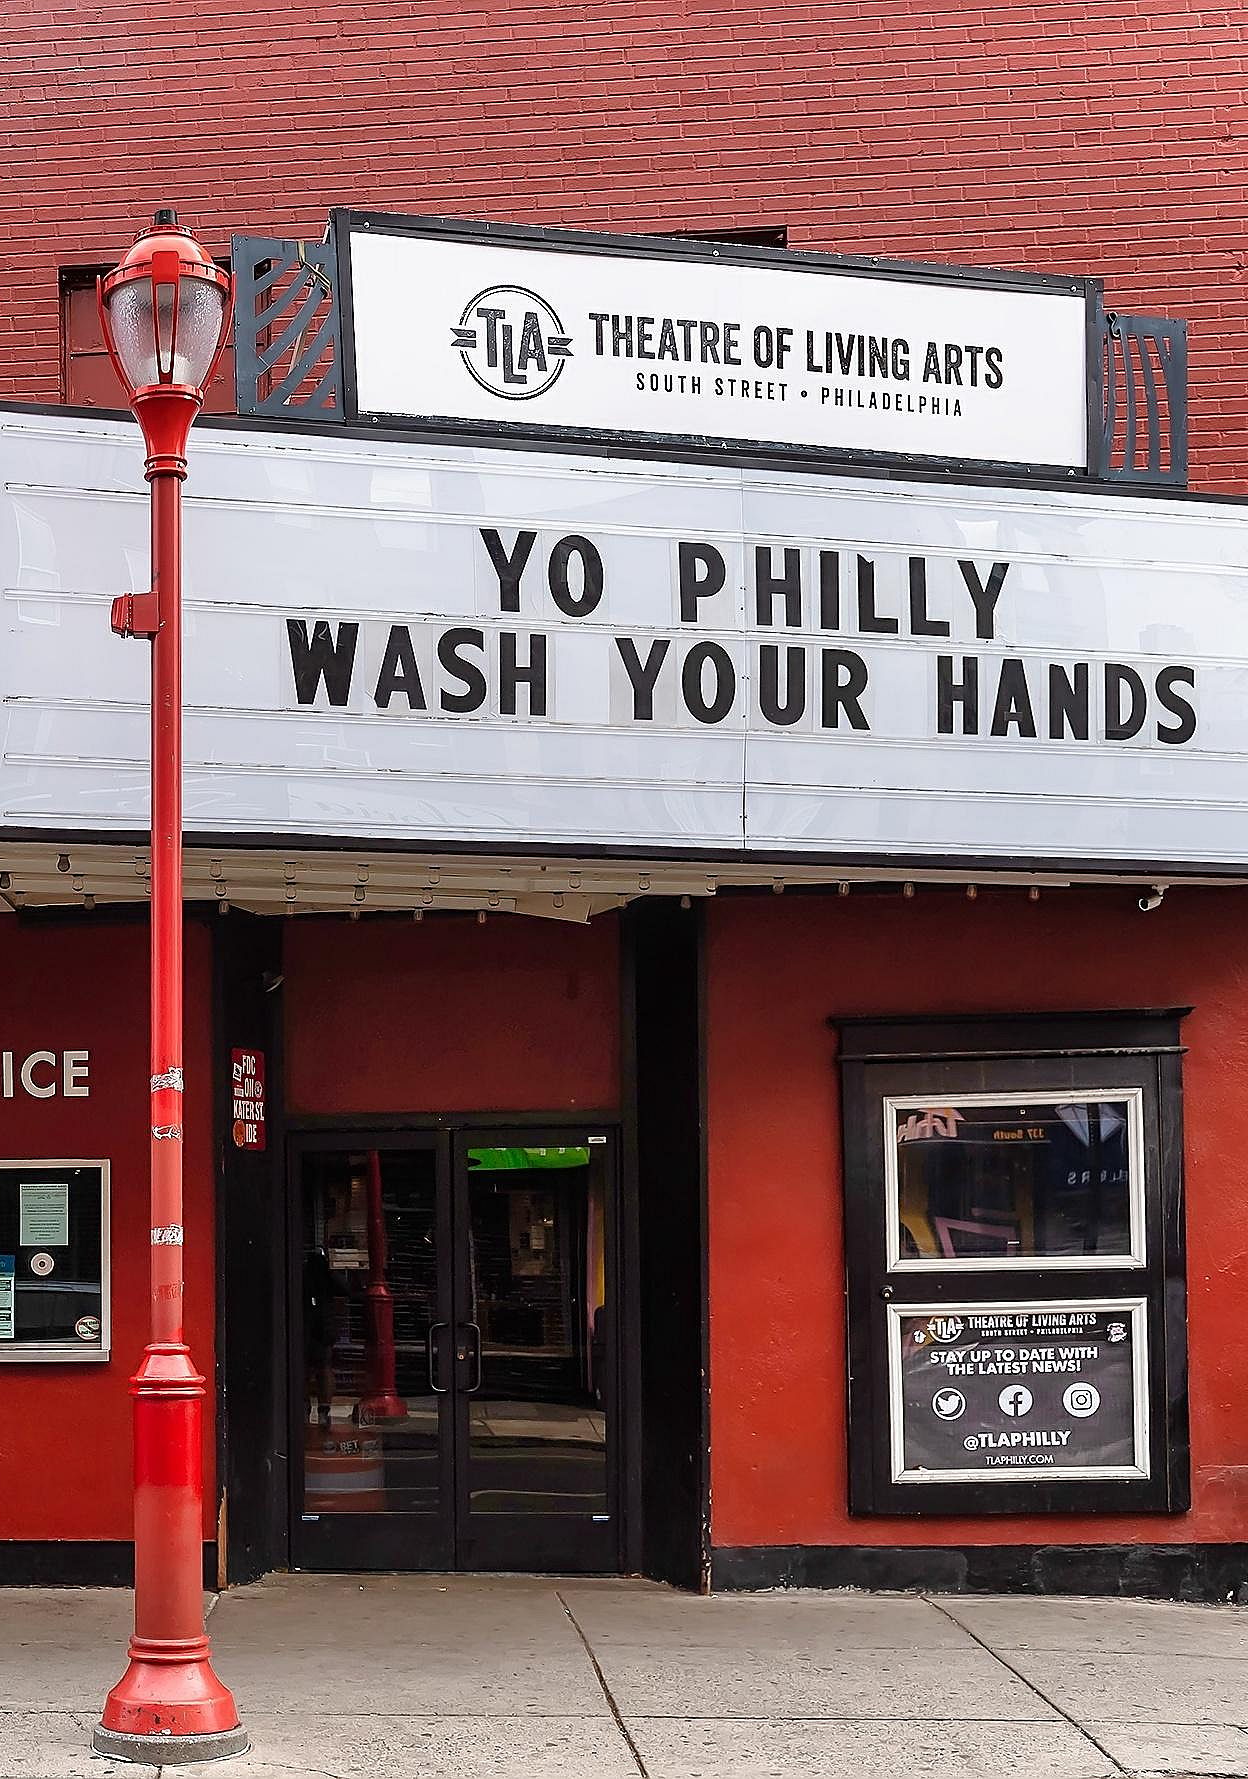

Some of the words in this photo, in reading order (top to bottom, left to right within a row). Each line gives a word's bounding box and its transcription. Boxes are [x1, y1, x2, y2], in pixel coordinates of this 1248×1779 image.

[477, 307, 548, 385] TLA
[588, 312, 742, 367] THEATRE
[753, 325, 794, 371] OF
[806, 329, 910, 382] LIVING
[922, 341, 1004, 390] ARTS
[636, 372, 701, 395] SOUTH
[714, 377, 788, 402] STREET
[821, 386, 962, 417] PHILADELPHIA
[478, 527, 604, 618] YO
[678, 541, 1010, 640] PHILLY
[285, 618, 547, 717] WASH
[614, 636, 871, 731] YOUR
[937, 654, 1197, 745] HANDS
[233, 1099, 255, 1121] KATER
[934, 1316, 957, 1339] TLA
[967, 1315, 1014, 1329] THEATRE
[1015, 1314, 1029, 1328] OF
[1031, 1314, 1067, 1327] LIVING
[1068, 1312, 1097, 1326] ARTS
[929, 1350, 966, 1365] STAY
[970, 1350, 992, 1363] UP
[994, 1348, 1016, 1362] TO
[1019, 1347, 1055, 1361] DATE
[1057, 1346, 1098, 1360] WITH
[946, 1362, 975, 1376] THE
[978, 1361, 1029, 1375] LATEST
[1031, 1359, 1081, 1373] NEWS!
[963, 1430, 1071, 1451] @TLAPHILLY
[985, 1454, 1054, 1466] TLAPHILLY.COM
